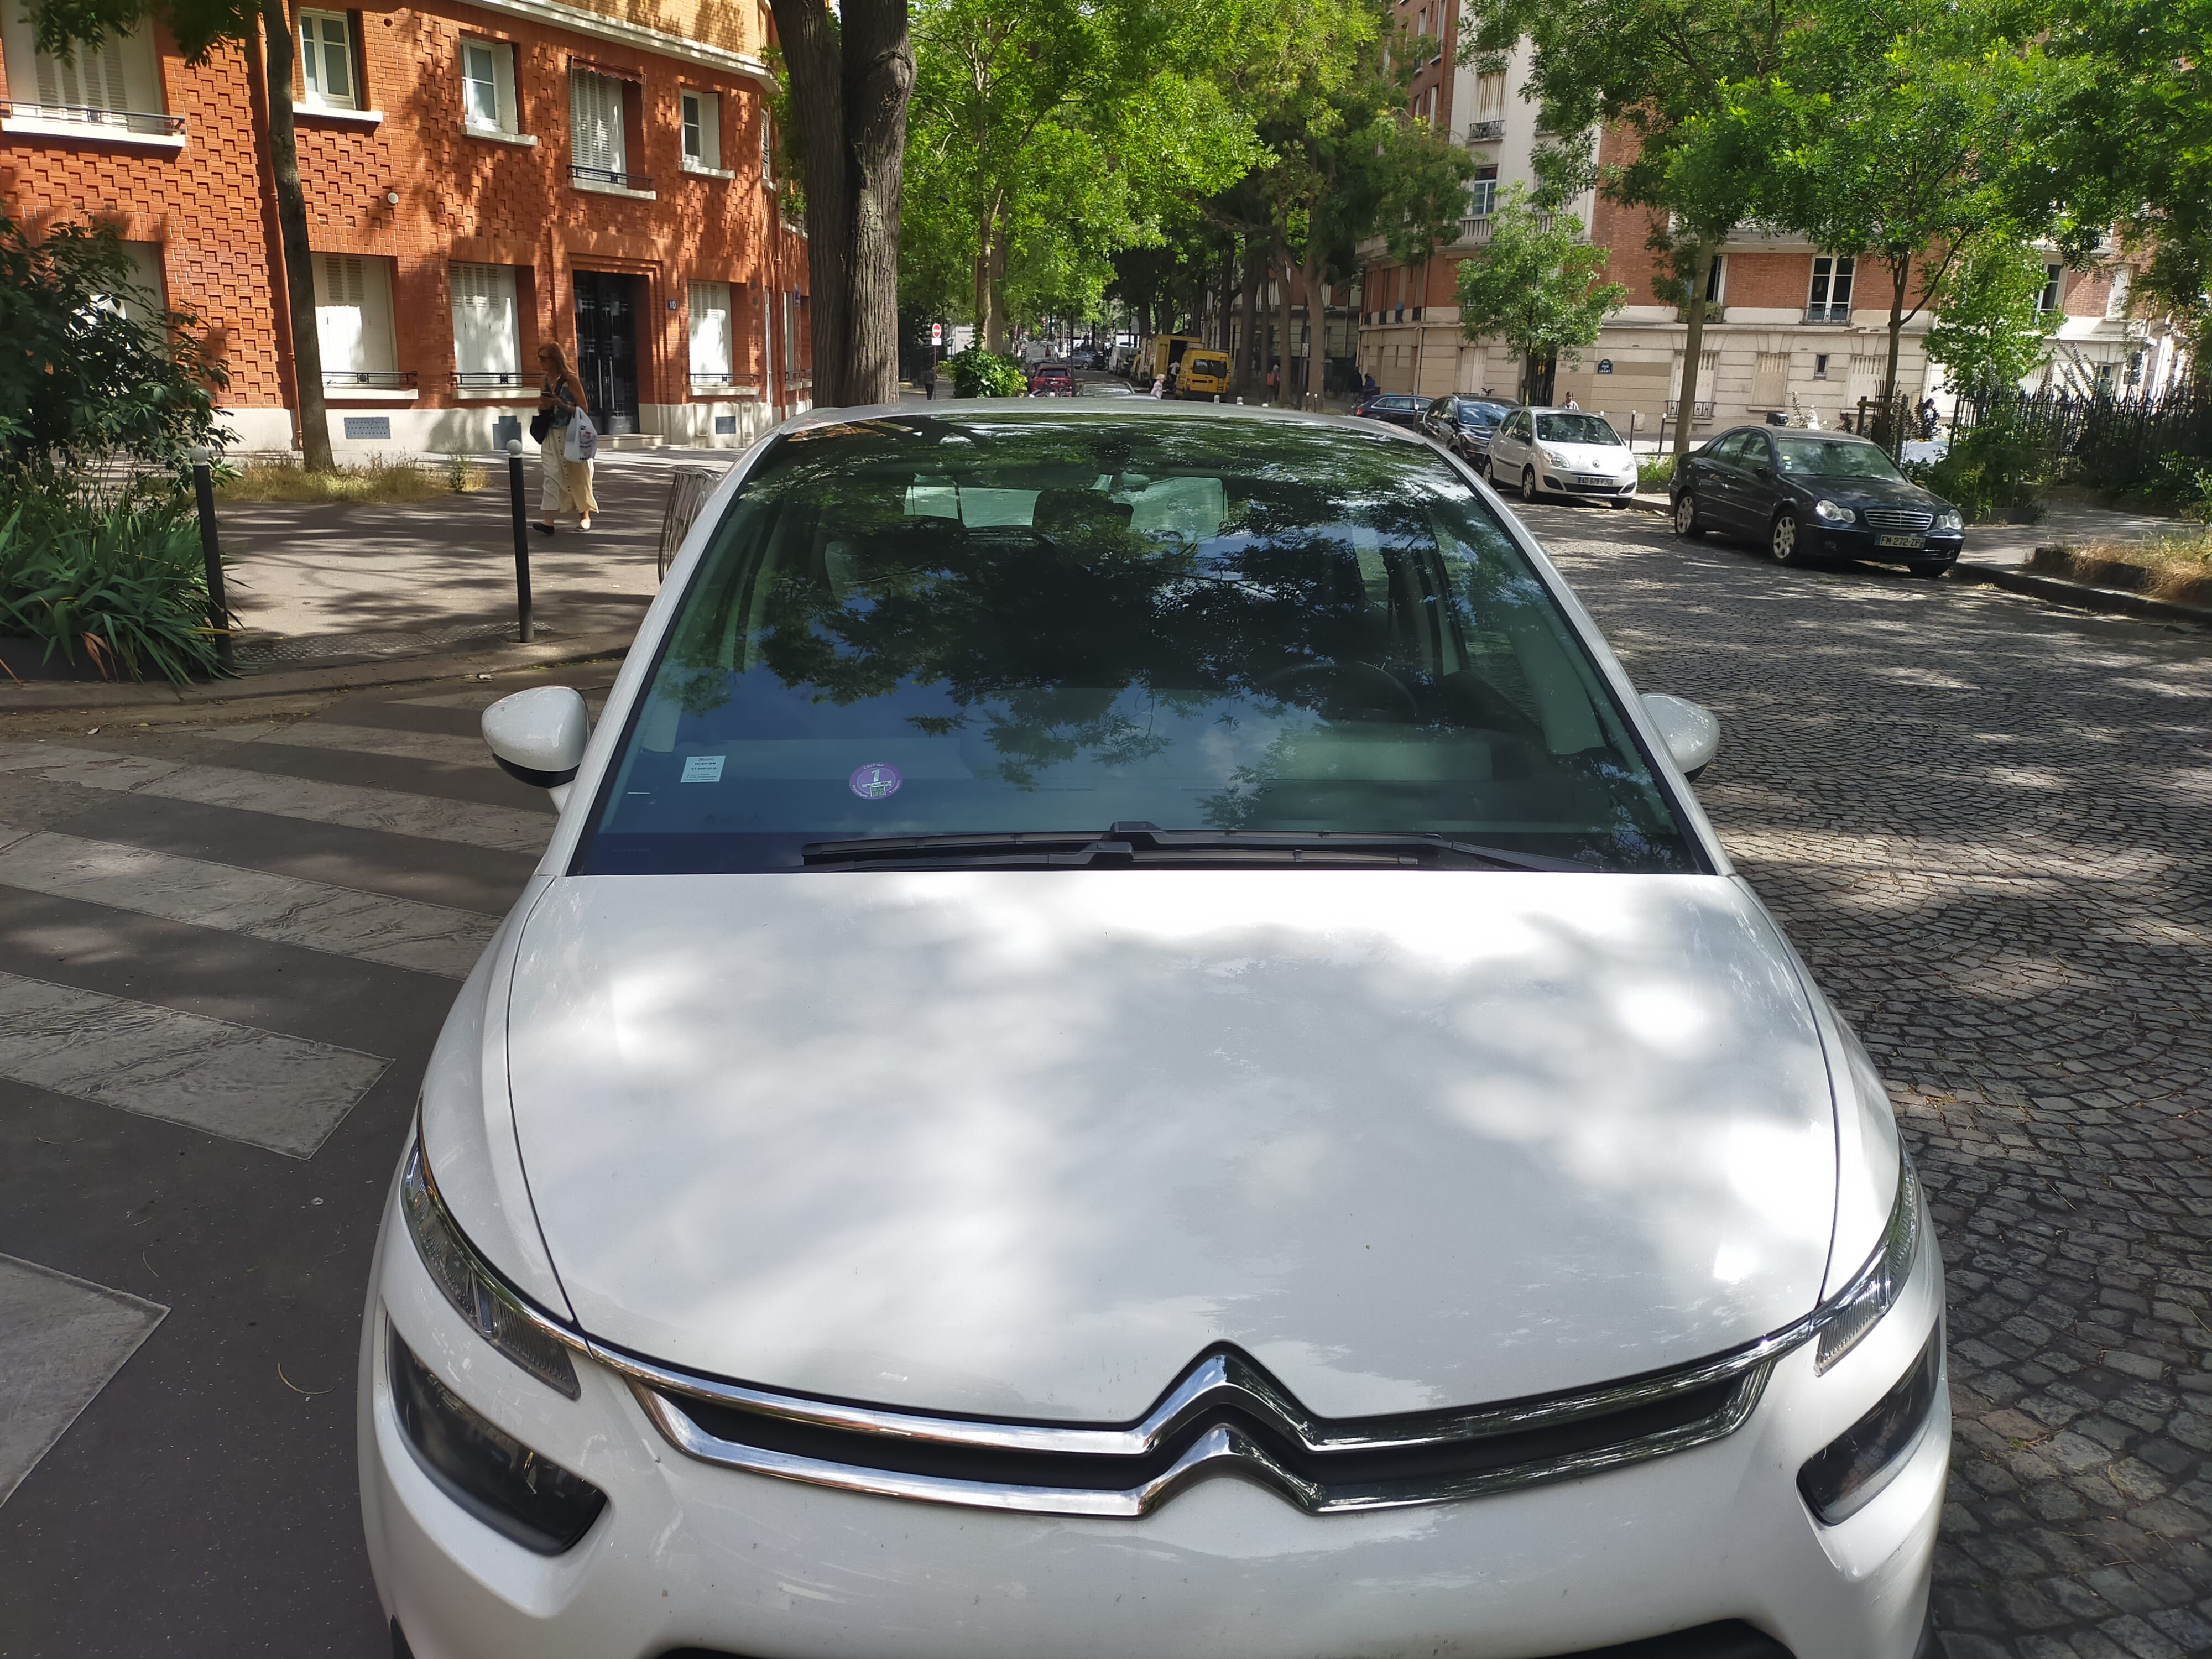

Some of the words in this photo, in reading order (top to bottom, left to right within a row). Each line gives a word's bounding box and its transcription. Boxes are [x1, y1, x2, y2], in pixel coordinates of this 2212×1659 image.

[669, 300, 676, 310] 10
[1881, 536, 1921, 546] FM-272-ZP
[872, 769, 880, 782] 1
